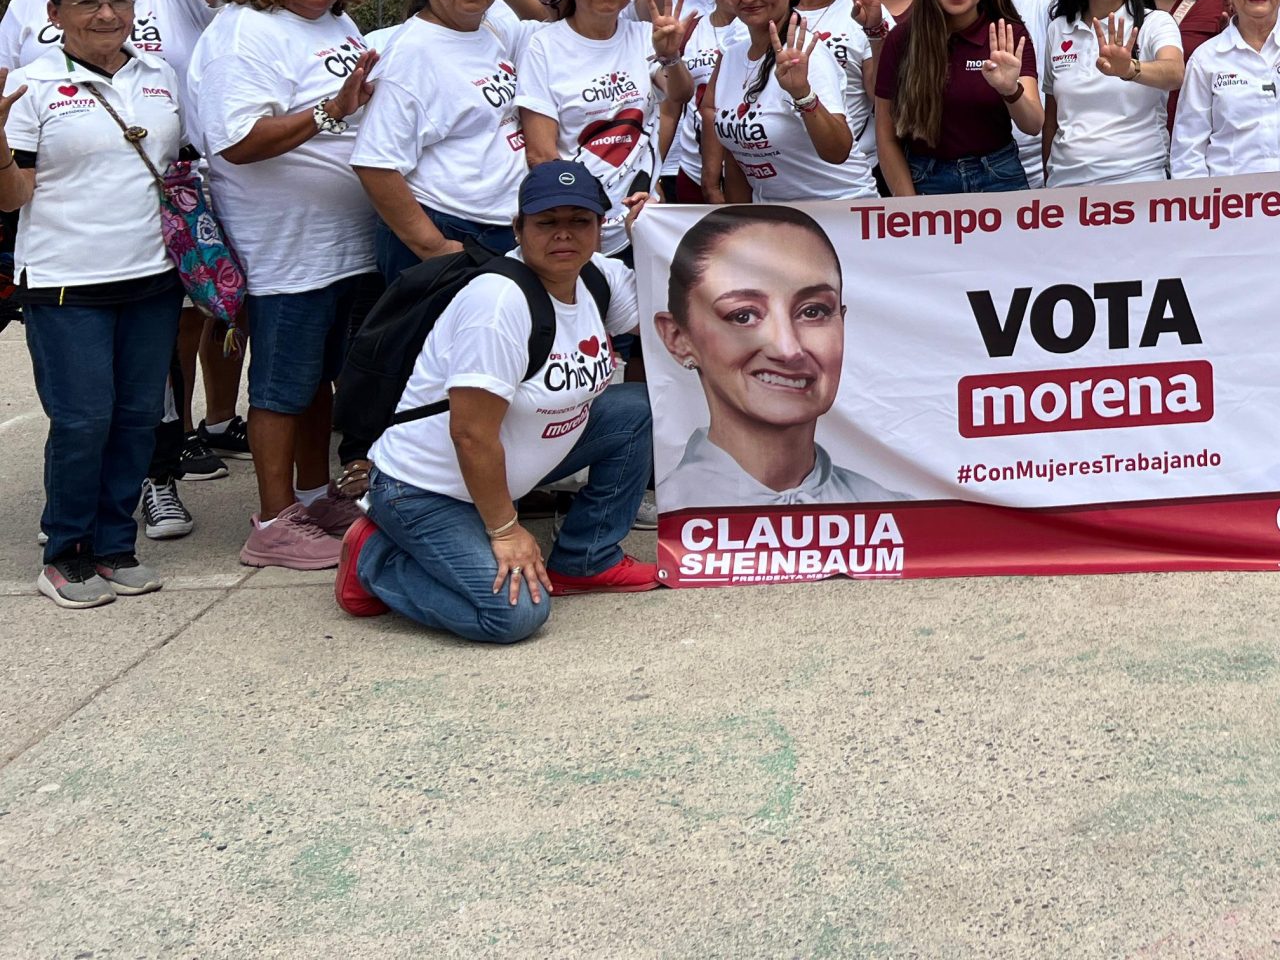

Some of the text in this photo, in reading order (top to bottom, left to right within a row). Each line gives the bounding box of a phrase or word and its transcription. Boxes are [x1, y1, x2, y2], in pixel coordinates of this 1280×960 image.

[48, 98, 96, 110] CHUYITA
[591, 134, 633, 146] morena
[850, 206, 1002, 244] Tiempo
[1016, 200, 1064, 230] de
[1079, 196, 1135, 226] las
[966, 277, 1203, 358] VOTA
[544, 351, 612, 392] Chuyit
[970, 373, 1202, 427] morena
[957, 449, 1222, 483] #ConMujeresTrabajando
[680, 512, 904, 551] CLAUDIA
[679, 546, 904, 575] SHEINBAUM
[732, 574, 804, 583] PRESIDENTA
